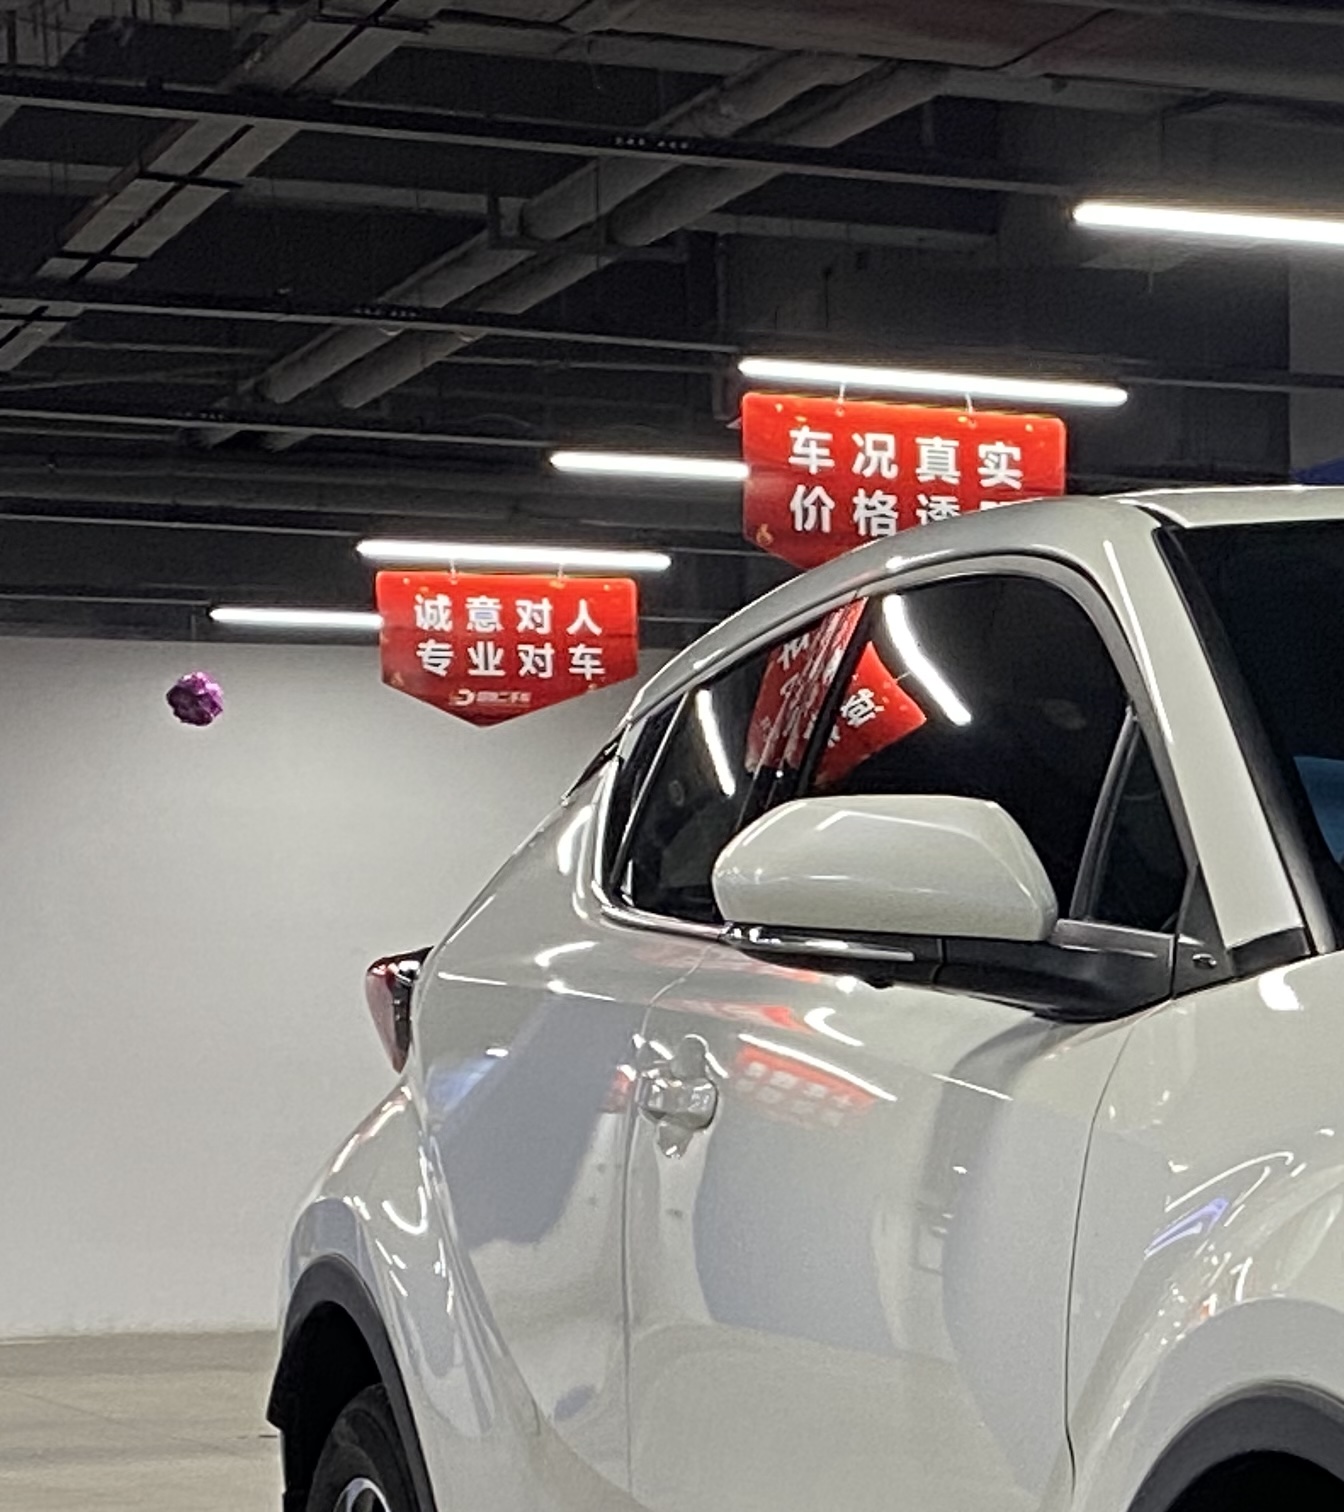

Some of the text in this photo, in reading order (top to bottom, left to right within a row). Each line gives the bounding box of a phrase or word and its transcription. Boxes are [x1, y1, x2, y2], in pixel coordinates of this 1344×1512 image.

[788, 425, 1024, 491] 车况真实
[788, 483, 1011, 537] 价格透
[413, 593, 603, 637] 诚意对人
[415, 638, 606, 681] 专业对车
